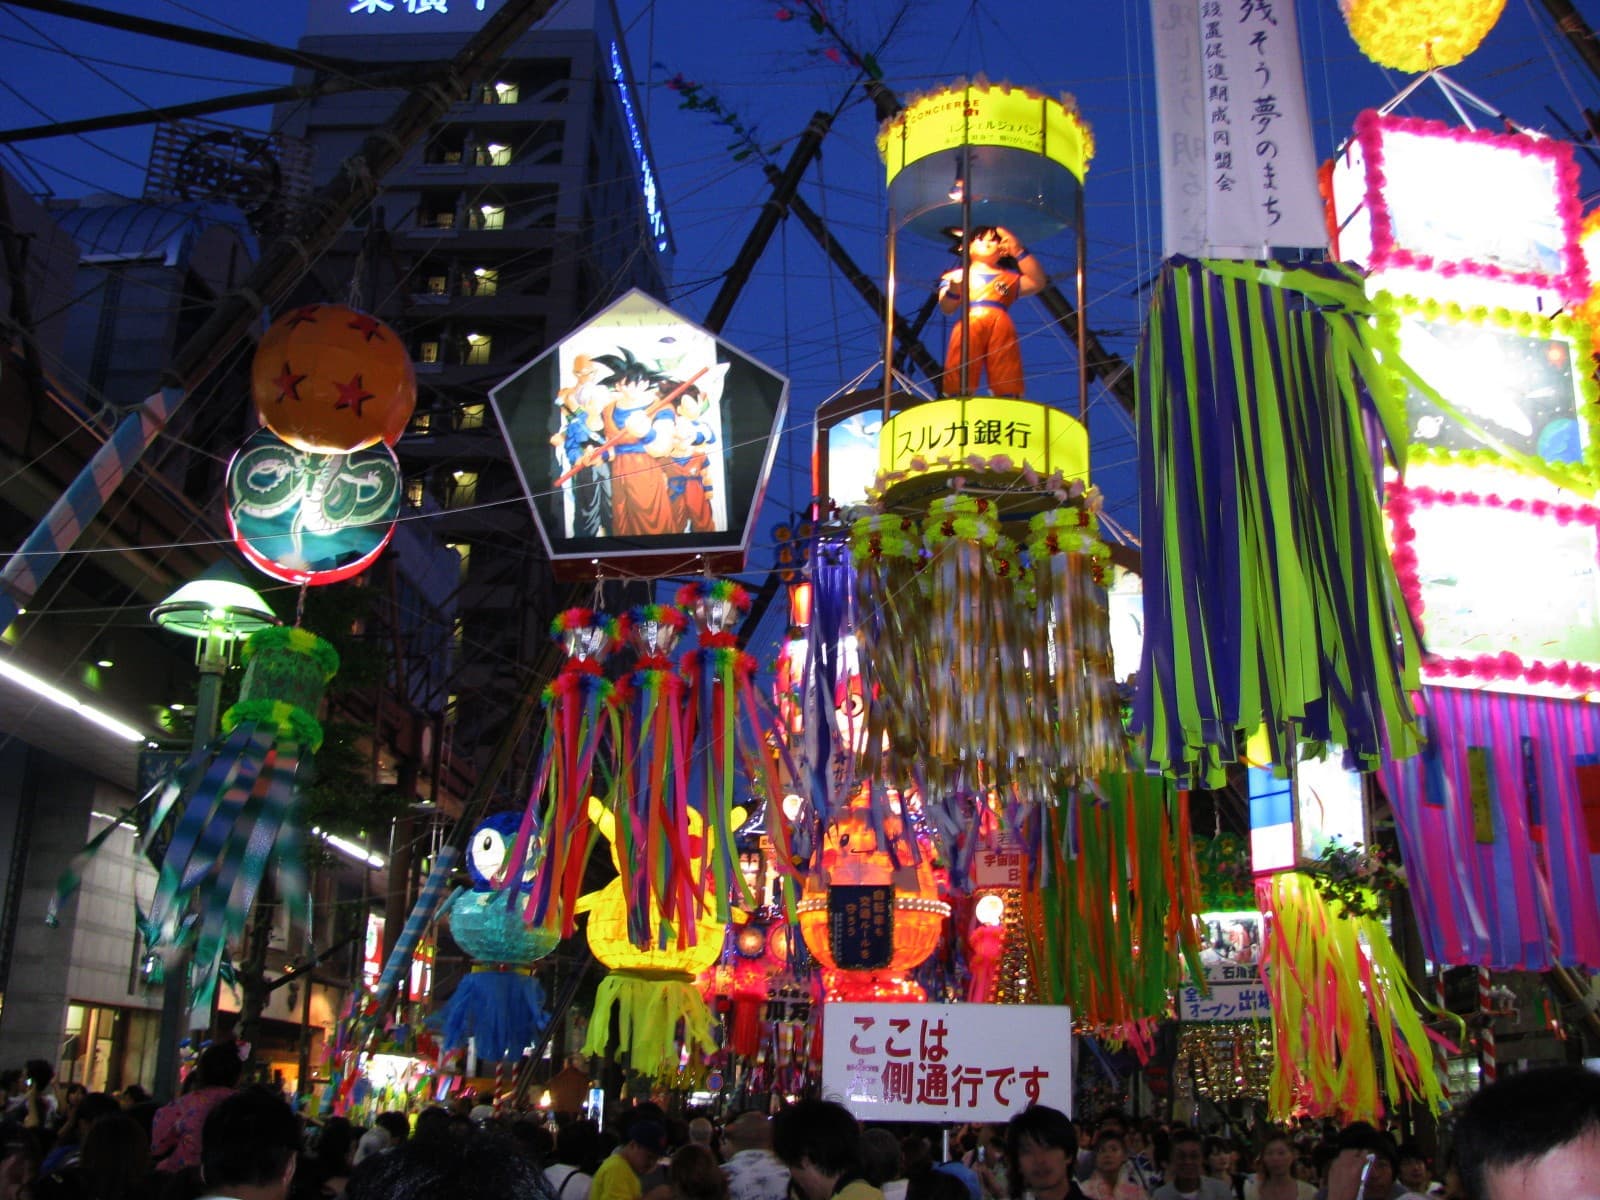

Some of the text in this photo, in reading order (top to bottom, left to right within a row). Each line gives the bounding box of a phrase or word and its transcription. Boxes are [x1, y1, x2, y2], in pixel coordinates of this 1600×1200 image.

[897, 419, 1031, 459] スルガ銀行
[1189, 1002, 1236, 1017] オープン
[849, 1016, 949, 1062] ここは
